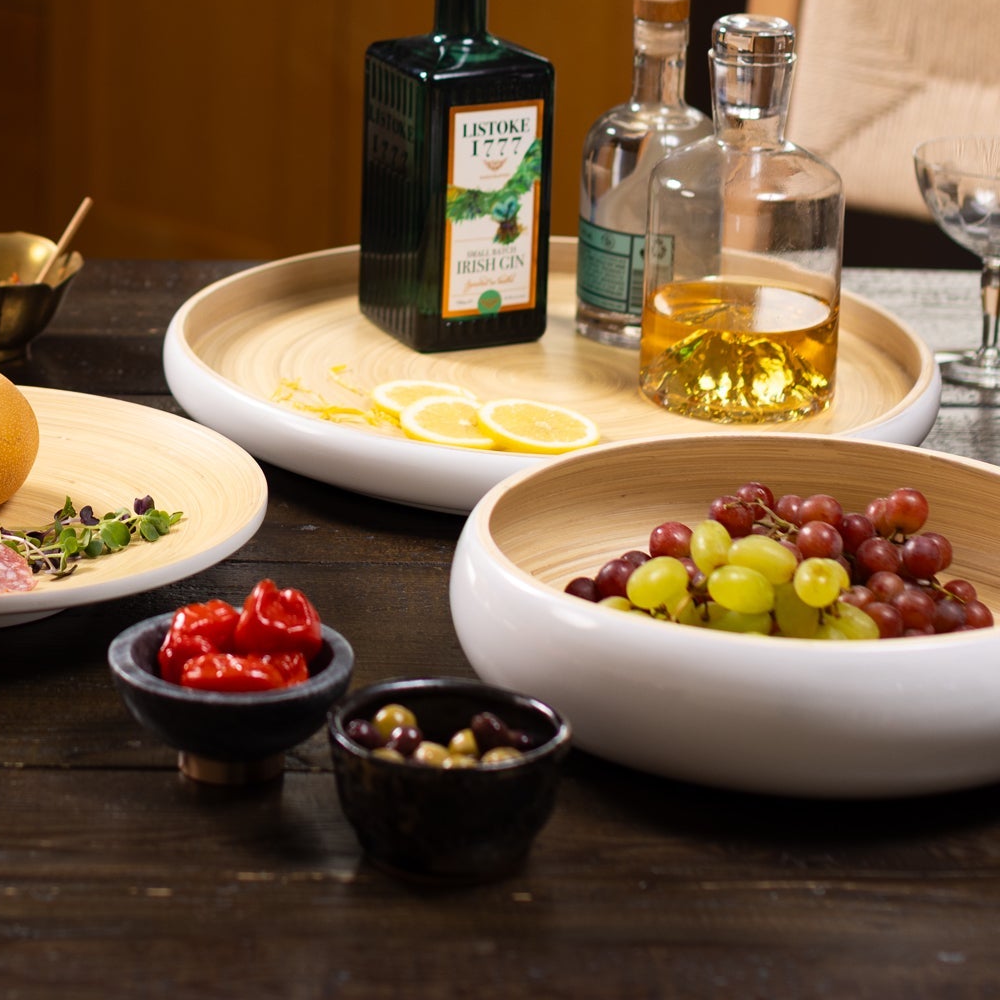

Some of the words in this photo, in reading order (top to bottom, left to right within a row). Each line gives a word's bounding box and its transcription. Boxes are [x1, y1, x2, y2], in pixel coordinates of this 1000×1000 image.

[463, 117, 530, 137] LISTOKE
[472, 137, 522, 157] 1777
[457, 258, 496, 274] IRISH
[499, 254, 524, 269] GIN
